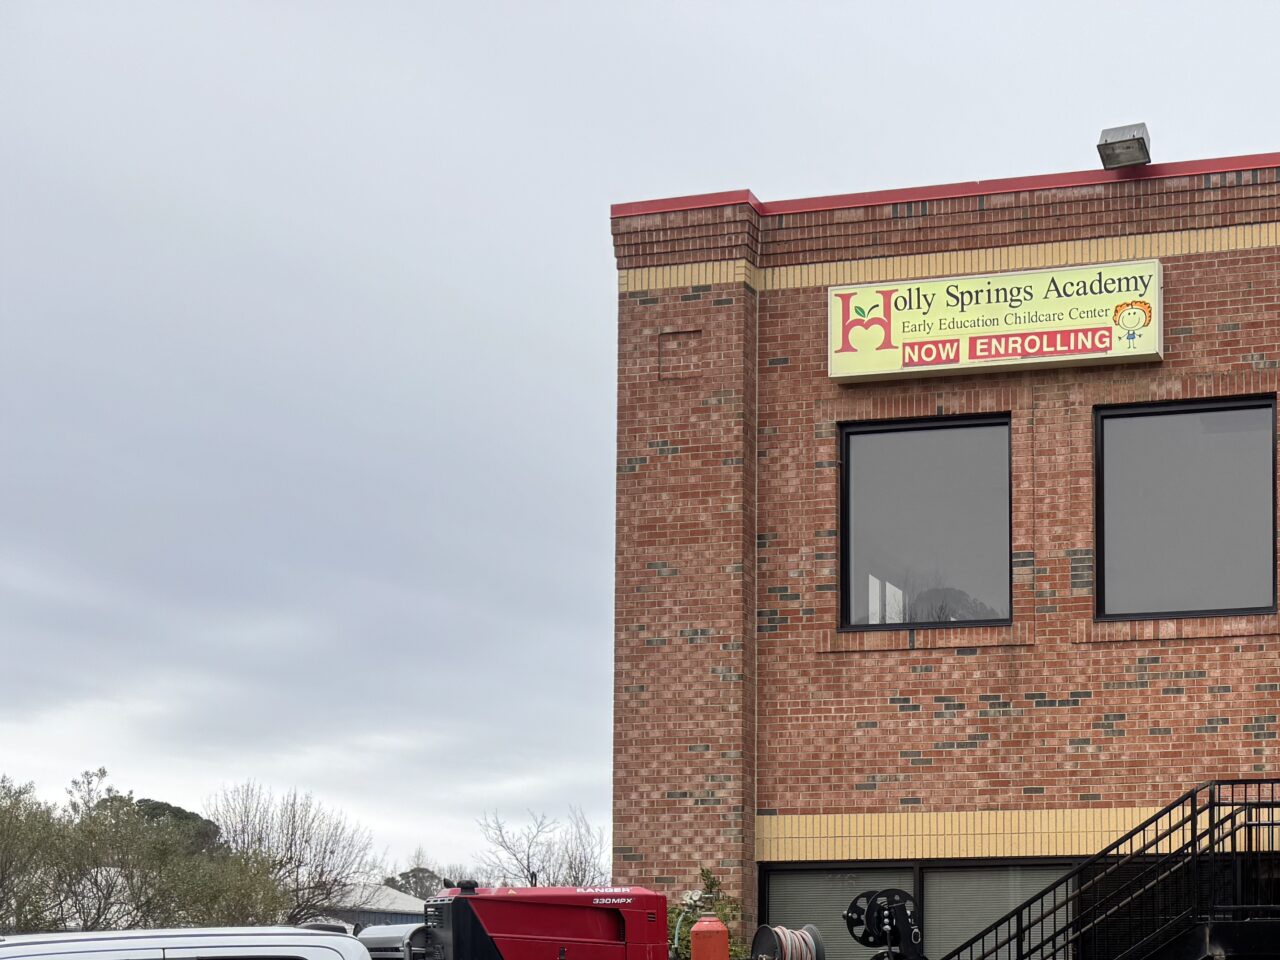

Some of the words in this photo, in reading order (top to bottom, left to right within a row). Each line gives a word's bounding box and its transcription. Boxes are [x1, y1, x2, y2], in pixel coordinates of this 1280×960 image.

[834, 286, 936, 354] Holly
[945, 281, 1034, 313] Springs
[1043, 271, 1153, 299] Academy
[902, 320, 934, 334] Early
[939, 315, 999, 331] Education
[1004, 311, 1064, 325] Childcare
[1069, 307, 1111, 320] Center
[904, 342, 958, 363] NOW
[976, 330, 1110, 356] ENROLLING
